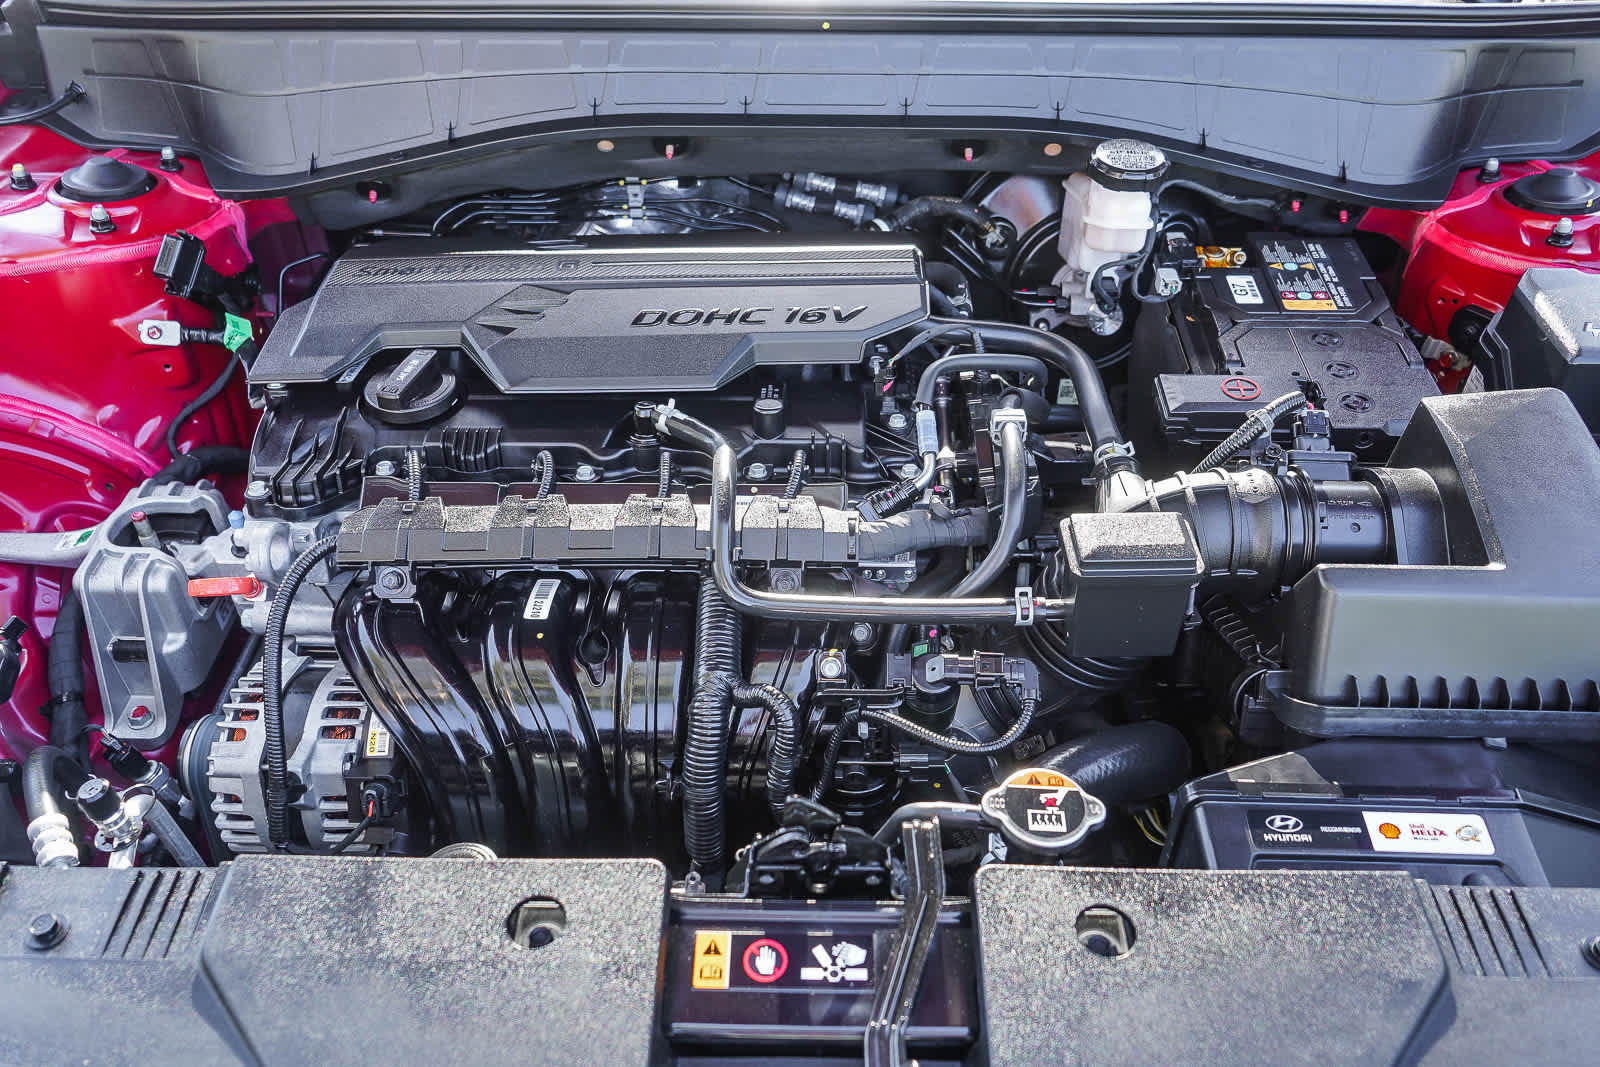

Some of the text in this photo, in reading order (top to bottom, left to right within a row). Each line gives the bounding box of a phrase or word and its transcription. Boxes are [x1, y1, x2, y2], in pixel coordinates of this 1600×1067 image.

[1231, 283, 1249, 296] G7
[630, 305, 869, 327] DOHC 16V
[530, 600, 545, 618] 22210
[1263, 833, 1313, 843] HYUNDAI
[1411, 828, 1447, 836] HELIX
